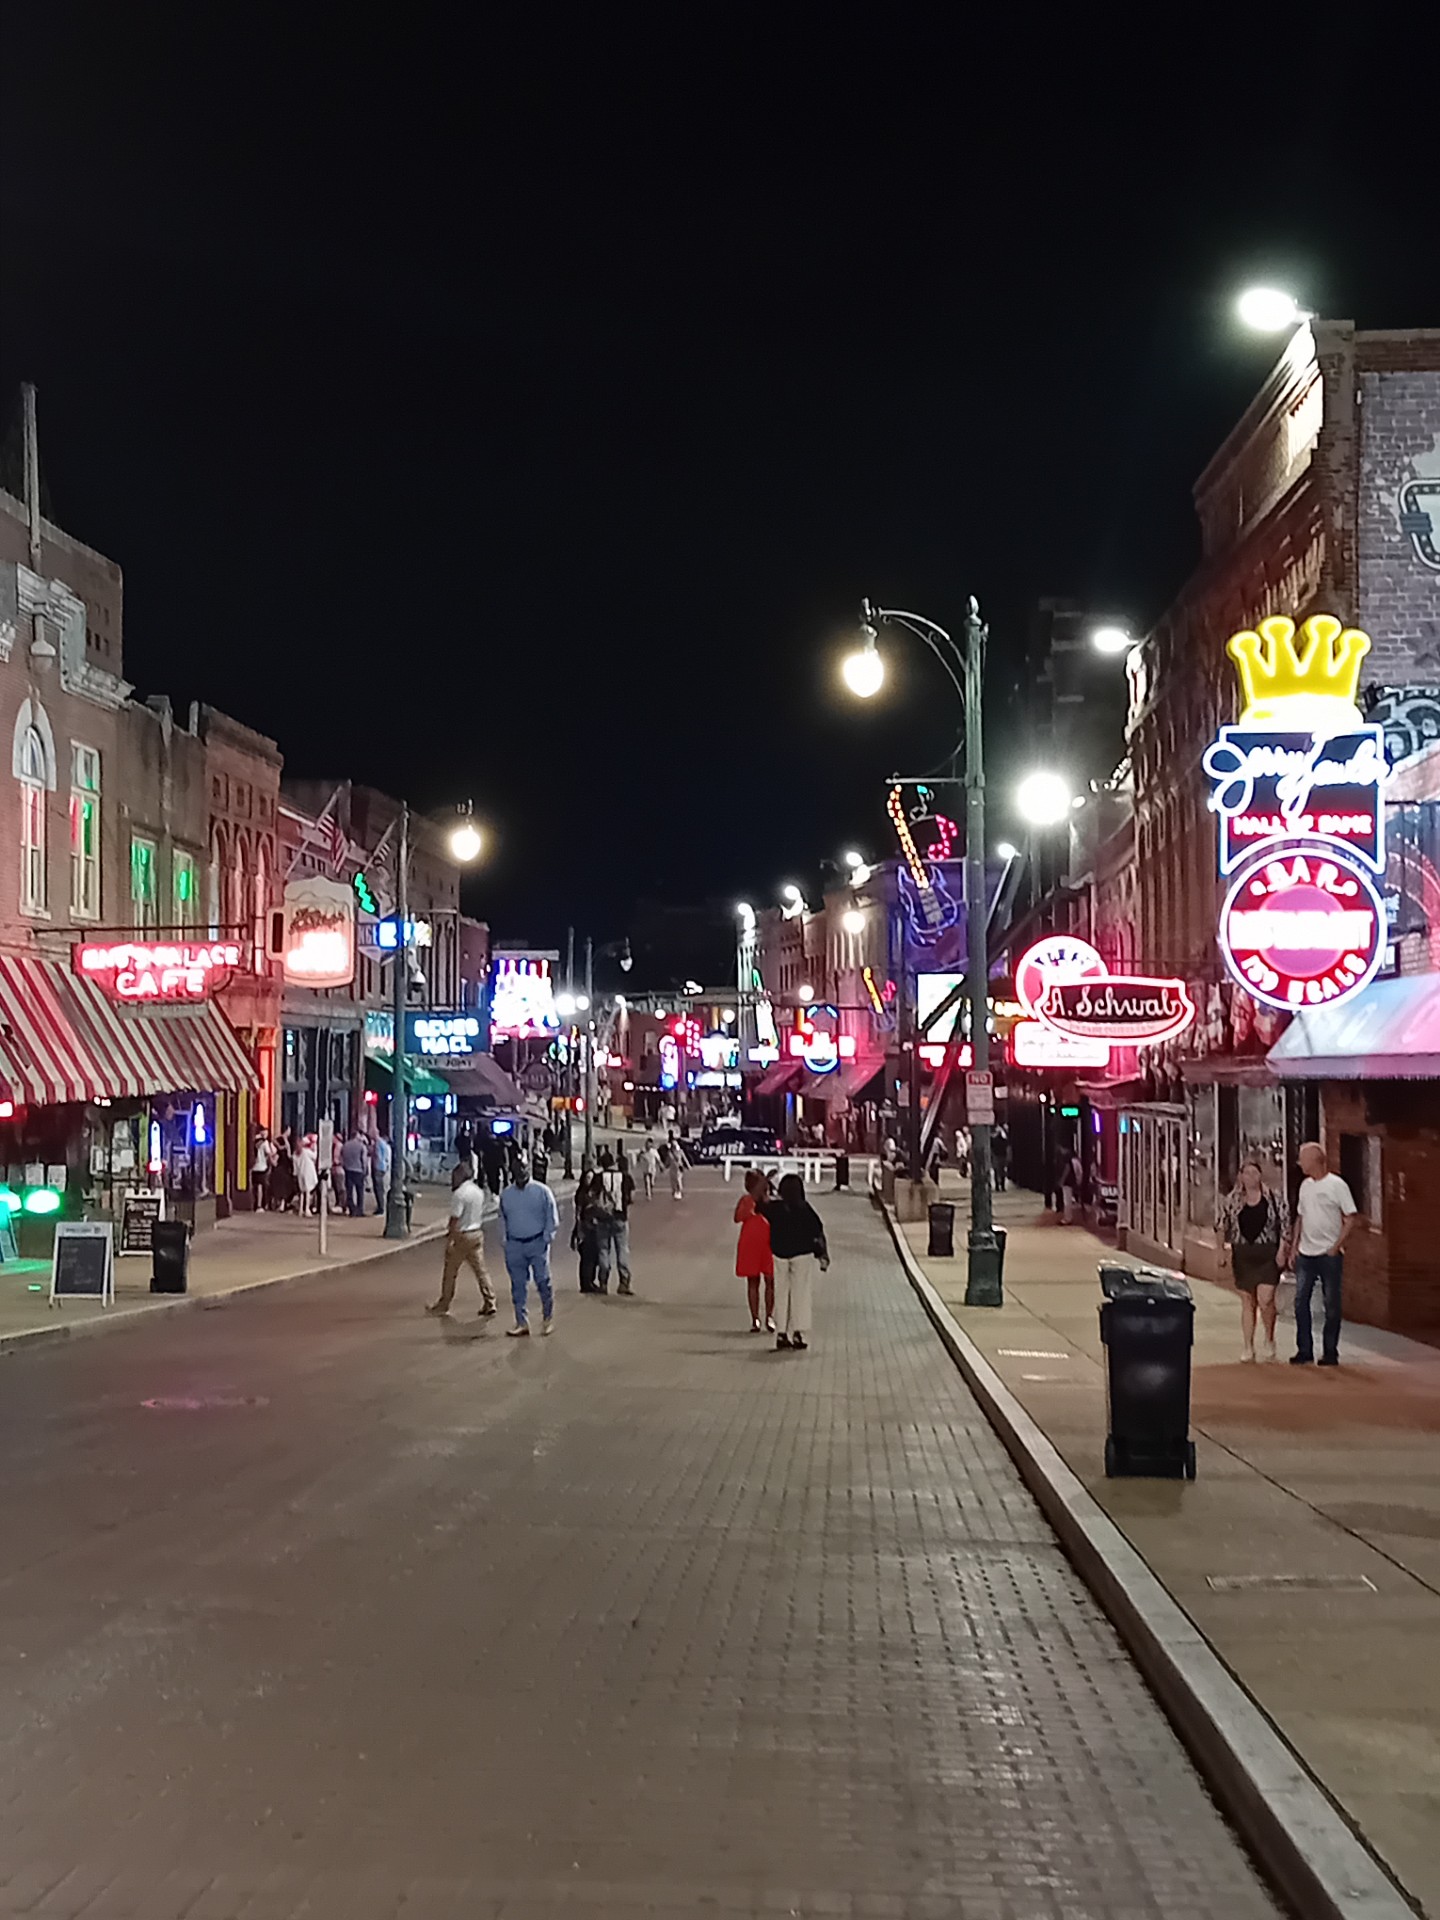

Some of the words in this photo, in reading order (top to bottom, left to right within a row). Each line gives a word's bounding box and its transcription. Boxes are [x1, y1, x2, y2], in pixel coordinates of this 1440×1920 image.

[1265, 856, 1346, 895] BAR
[1241, 954, 1280, 992] 159
[1287, 953, 1368, 1003] BEALE
[1076, 986, 1183, 1018] Schwab
[414, 1018, 479, 1037] BLUES
[421, 1036, 472, 1054] HALL
